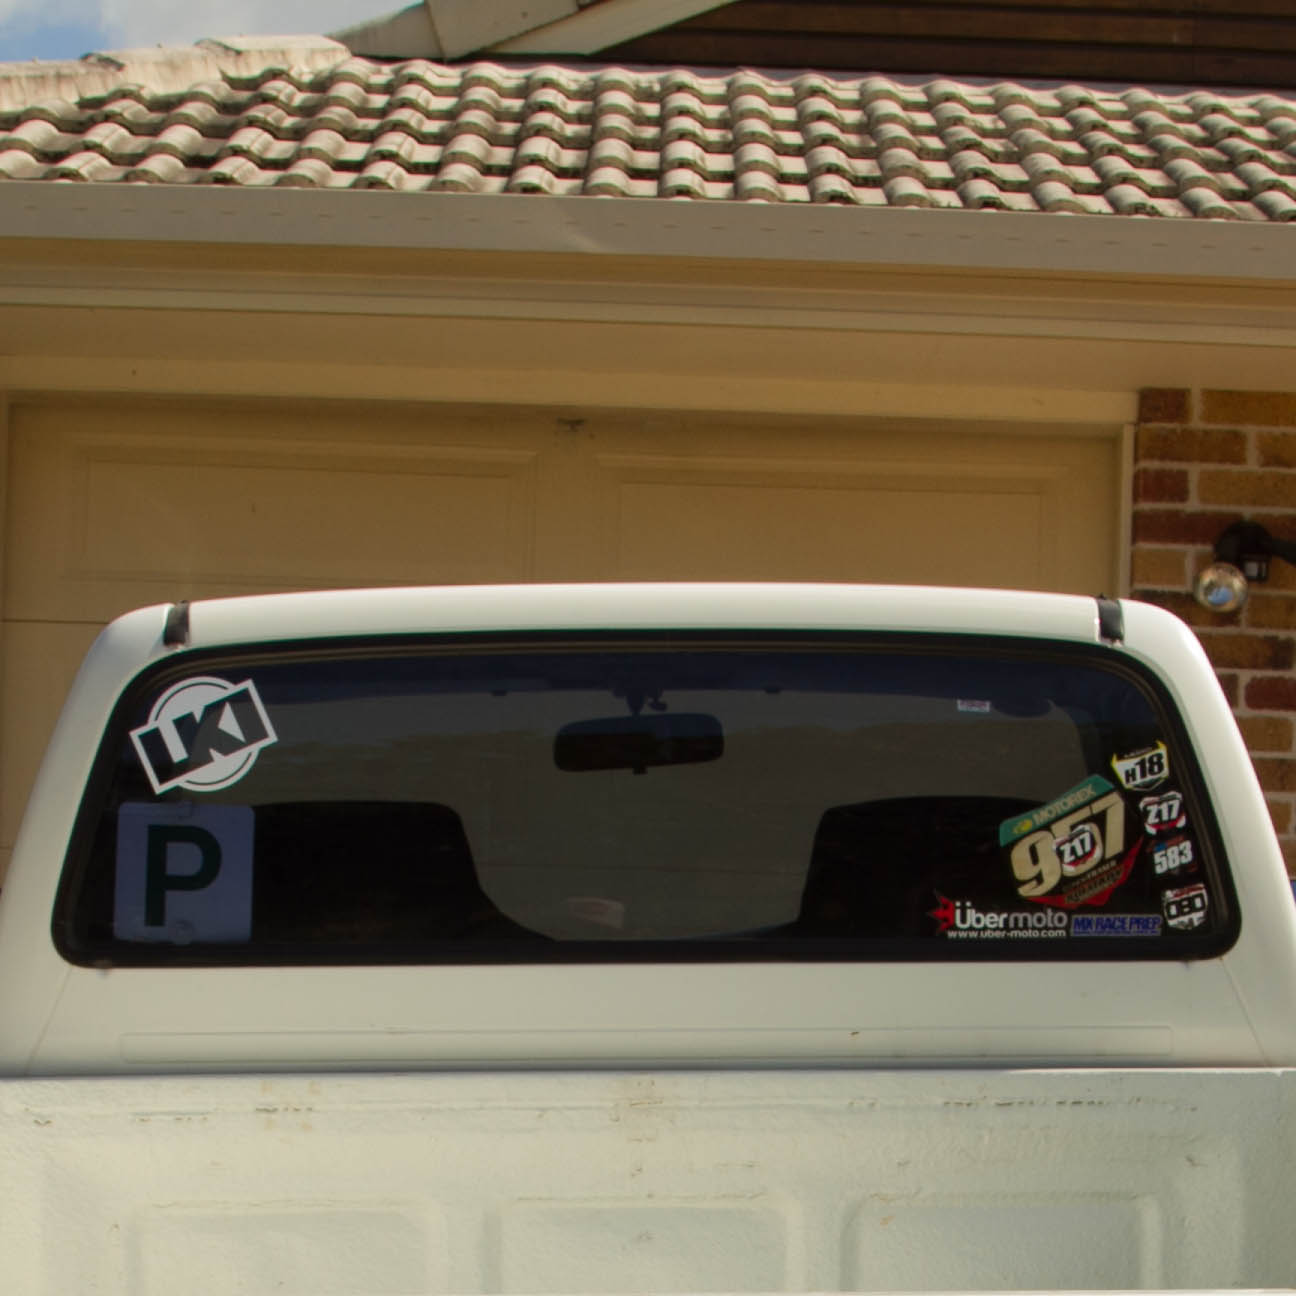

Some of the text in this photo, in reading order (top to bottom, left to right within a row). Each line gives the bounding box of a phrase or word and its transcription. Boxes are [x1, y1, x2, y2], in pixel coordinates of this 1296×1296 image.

[1146, 800, 1182, 825] Z17
[1154, 840, 1193, 875] 583
[145, 824, 223, 927] P
[947, 929, 1067, 939] www.uber-moto.com
[1095, 916, 1125, 929] RACE
[1129, 916, 1161, 929] PREP
